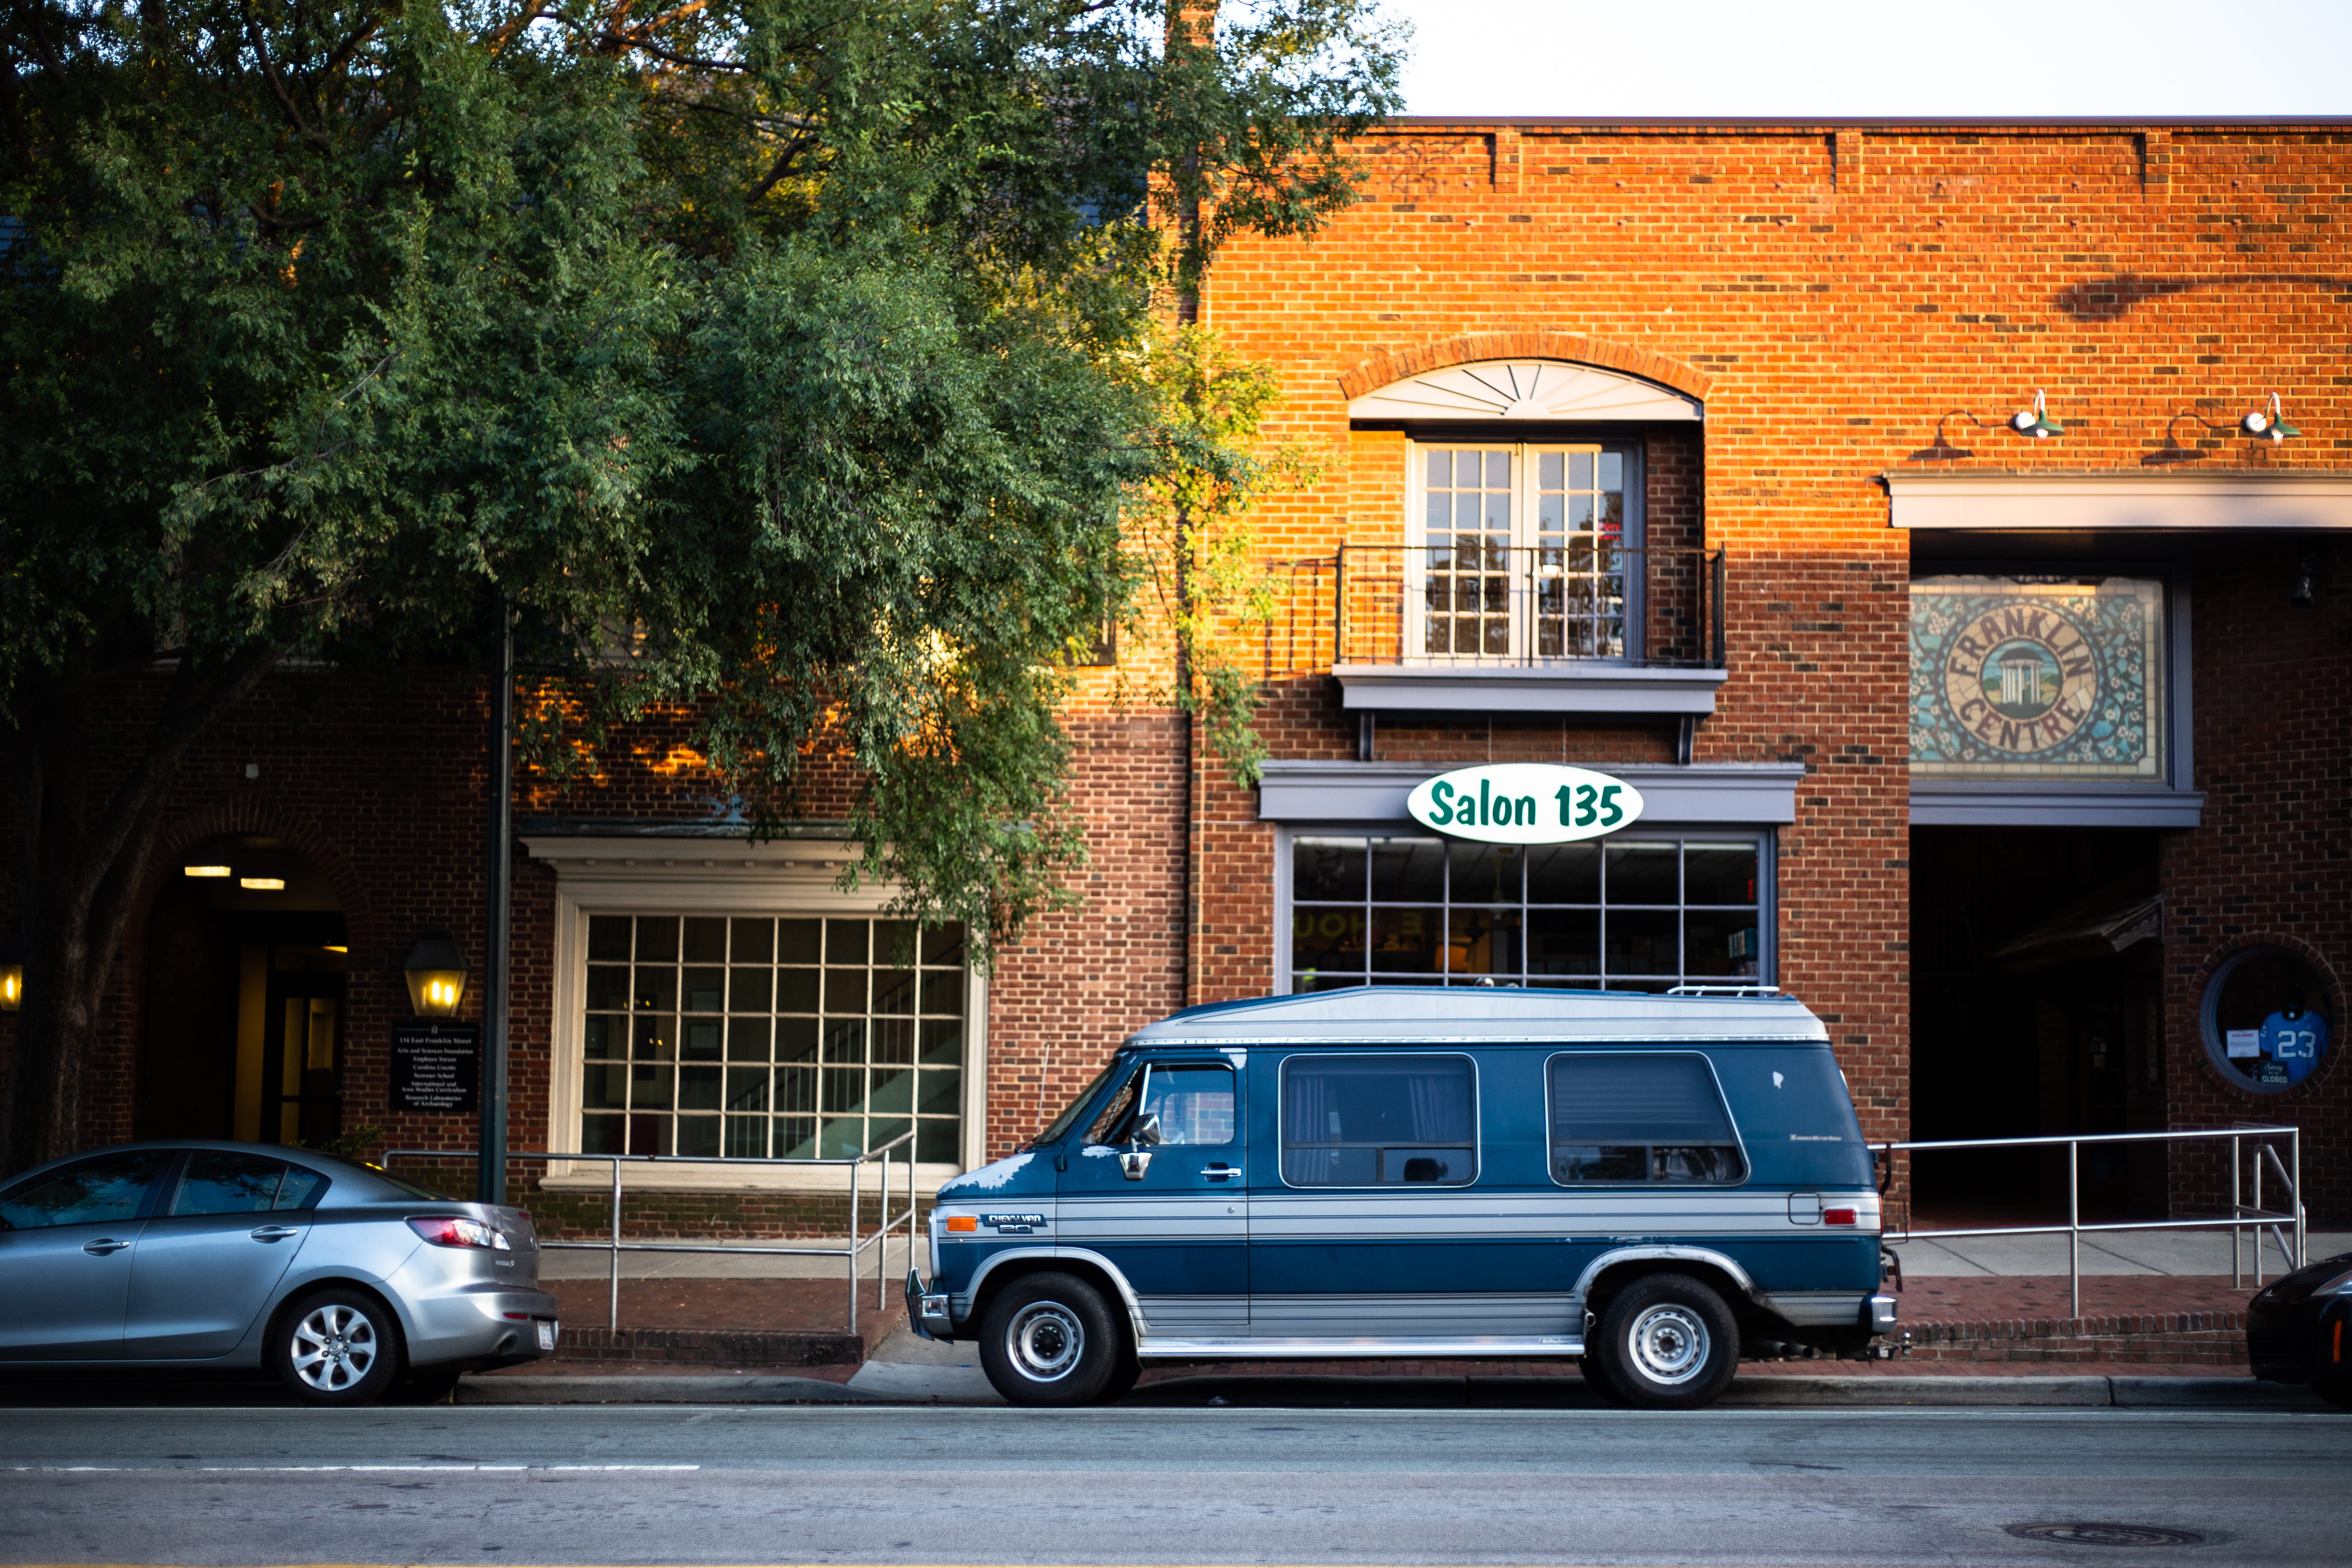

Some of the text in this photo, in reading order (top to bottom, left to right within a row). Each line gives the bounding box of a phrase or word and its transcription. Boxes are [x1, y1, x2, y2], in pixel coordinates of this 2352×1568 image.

[1950, 608, 2094, 678] FRANKLIN
[1960, 696, 2086, 750] CENTRE
[1428, 779, 1623, 827] Salon 135
[2278, 1030, 2316, 1059] 23
[2262, 1075, 2288, 1084] CLOSED
